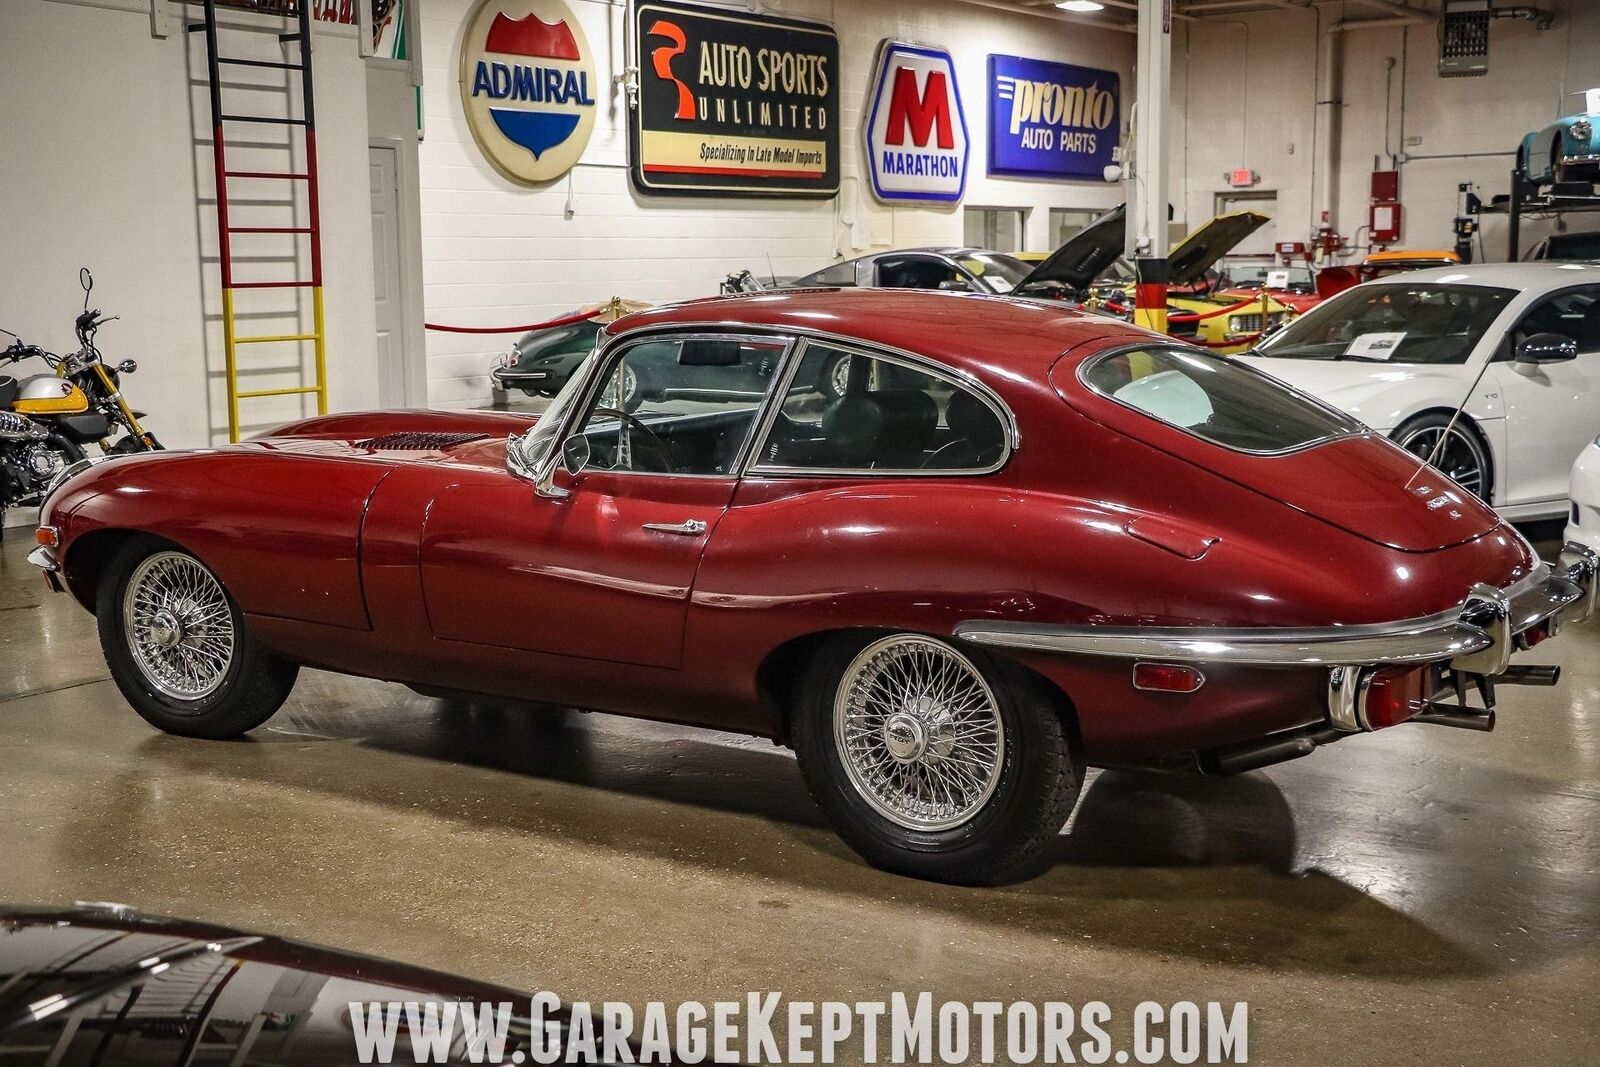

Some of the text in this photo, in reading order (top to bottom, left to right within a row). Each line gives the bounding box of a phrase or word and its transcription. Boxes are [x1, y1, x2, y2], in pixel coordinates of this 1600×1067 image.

[472, 60, 595, 106] ADMIRAL
[699, 41, 829, 98] AUTO SPORTS
[699, 96, 827, 130] UNLIMITED
[885, 66, 955, 149] M
[1009, 78, 1115, 135] pronto
[700, 142, 823, 166] Specializing In Late Model Imports
[1020, 127, 1097, 154] AUTO PARTS
[882, 150, 958, 178] MARATHON
